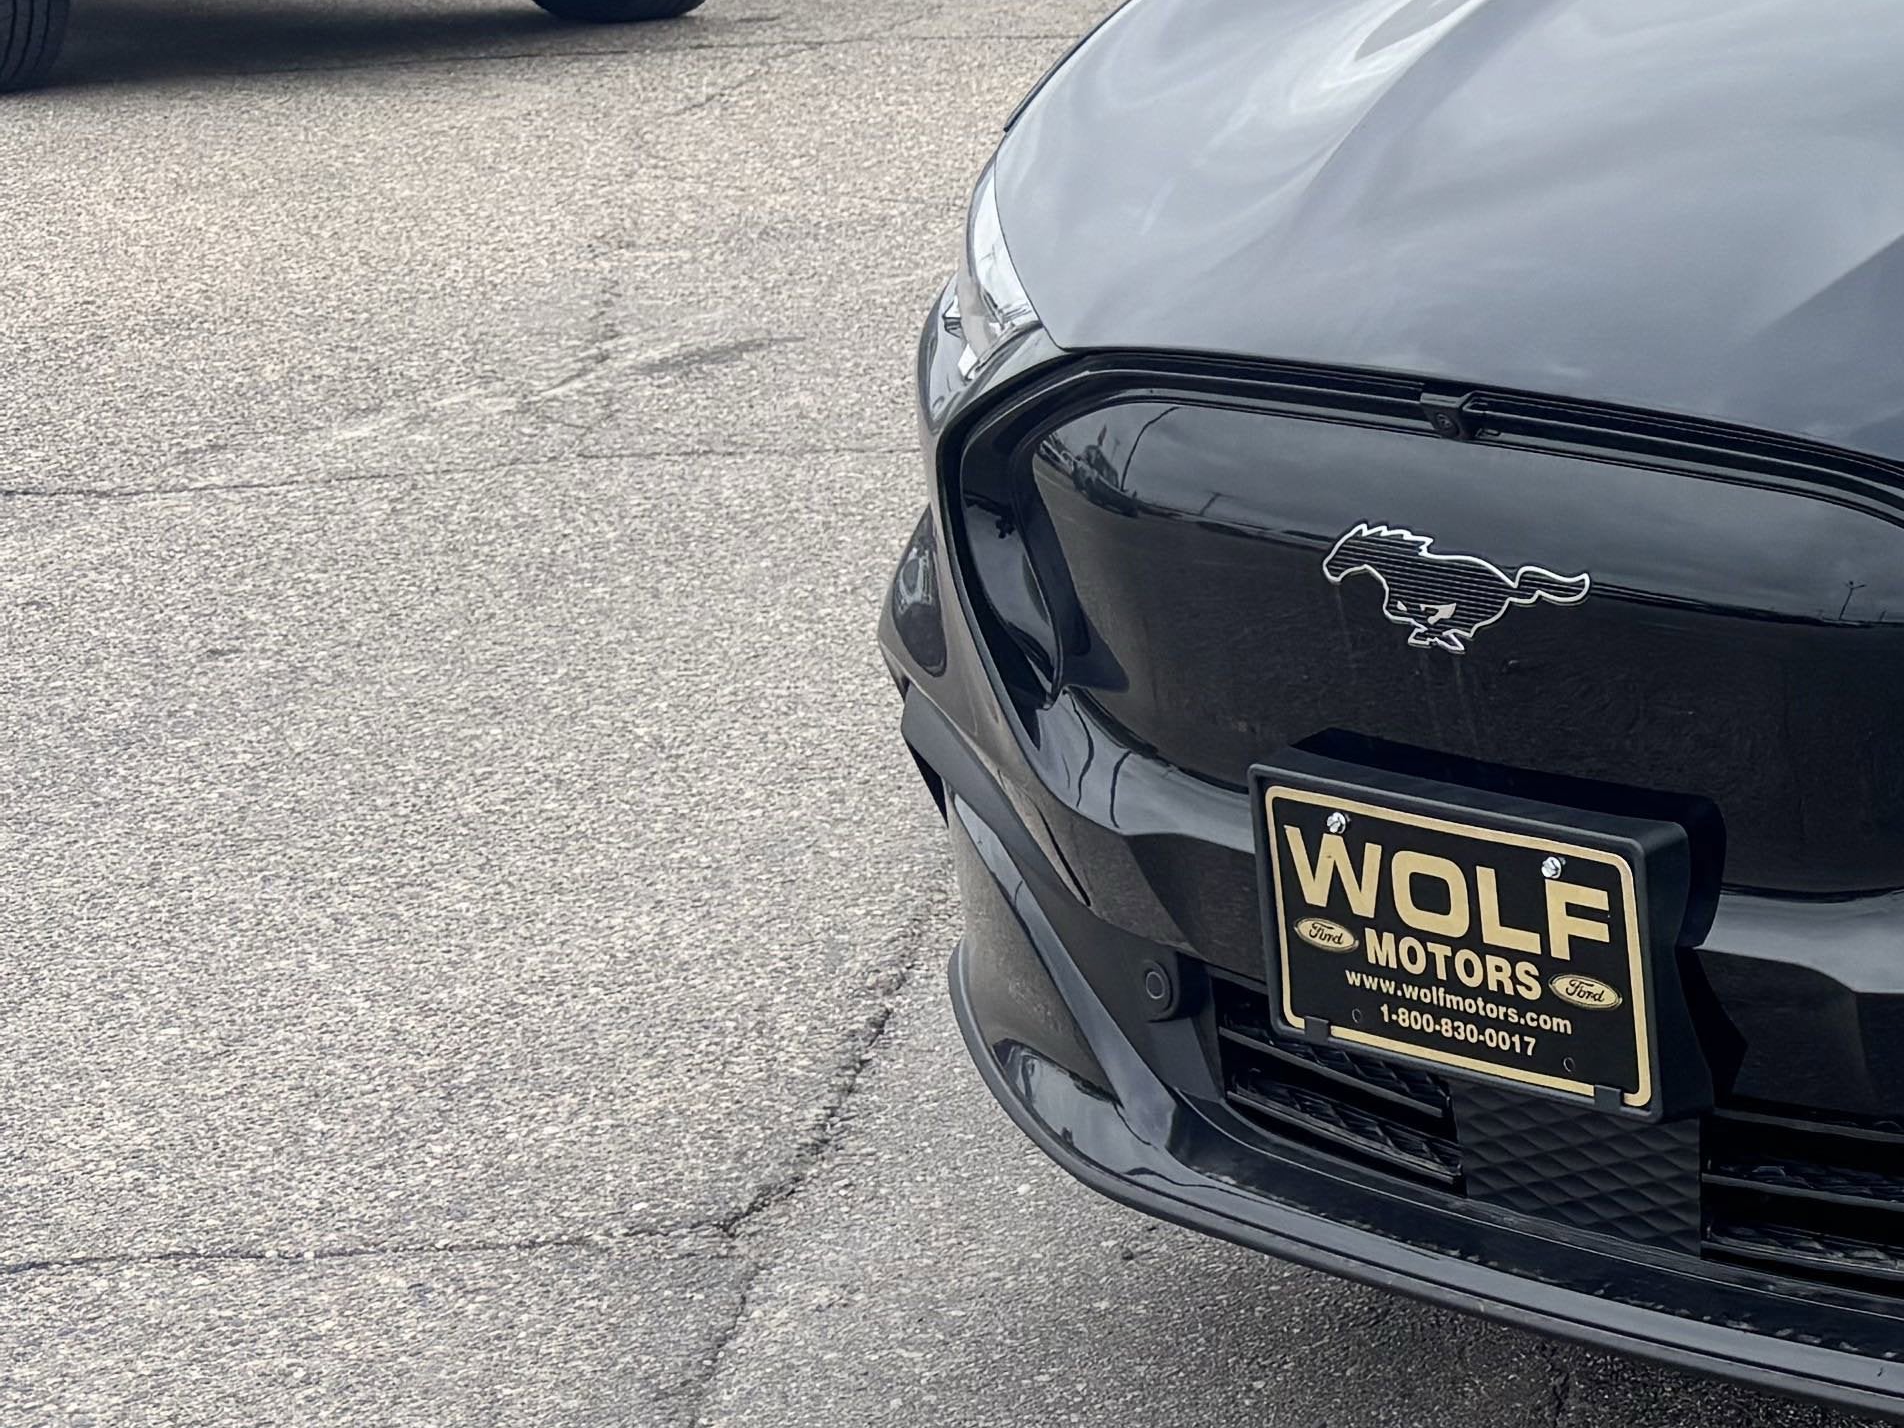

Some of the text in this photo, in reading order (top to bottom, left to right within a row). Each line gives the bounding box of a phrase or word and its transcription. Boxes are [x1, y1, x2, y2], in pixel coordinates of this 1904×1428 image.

[1283, 824, 1611, 961] WOLF
[1364, 927, 1542, 1001] MOTORS
[1345, 969, 1573, 1035] www.wolfmotors.com
[1379, 1003, 1537, 1056] 1-800-830-0017
